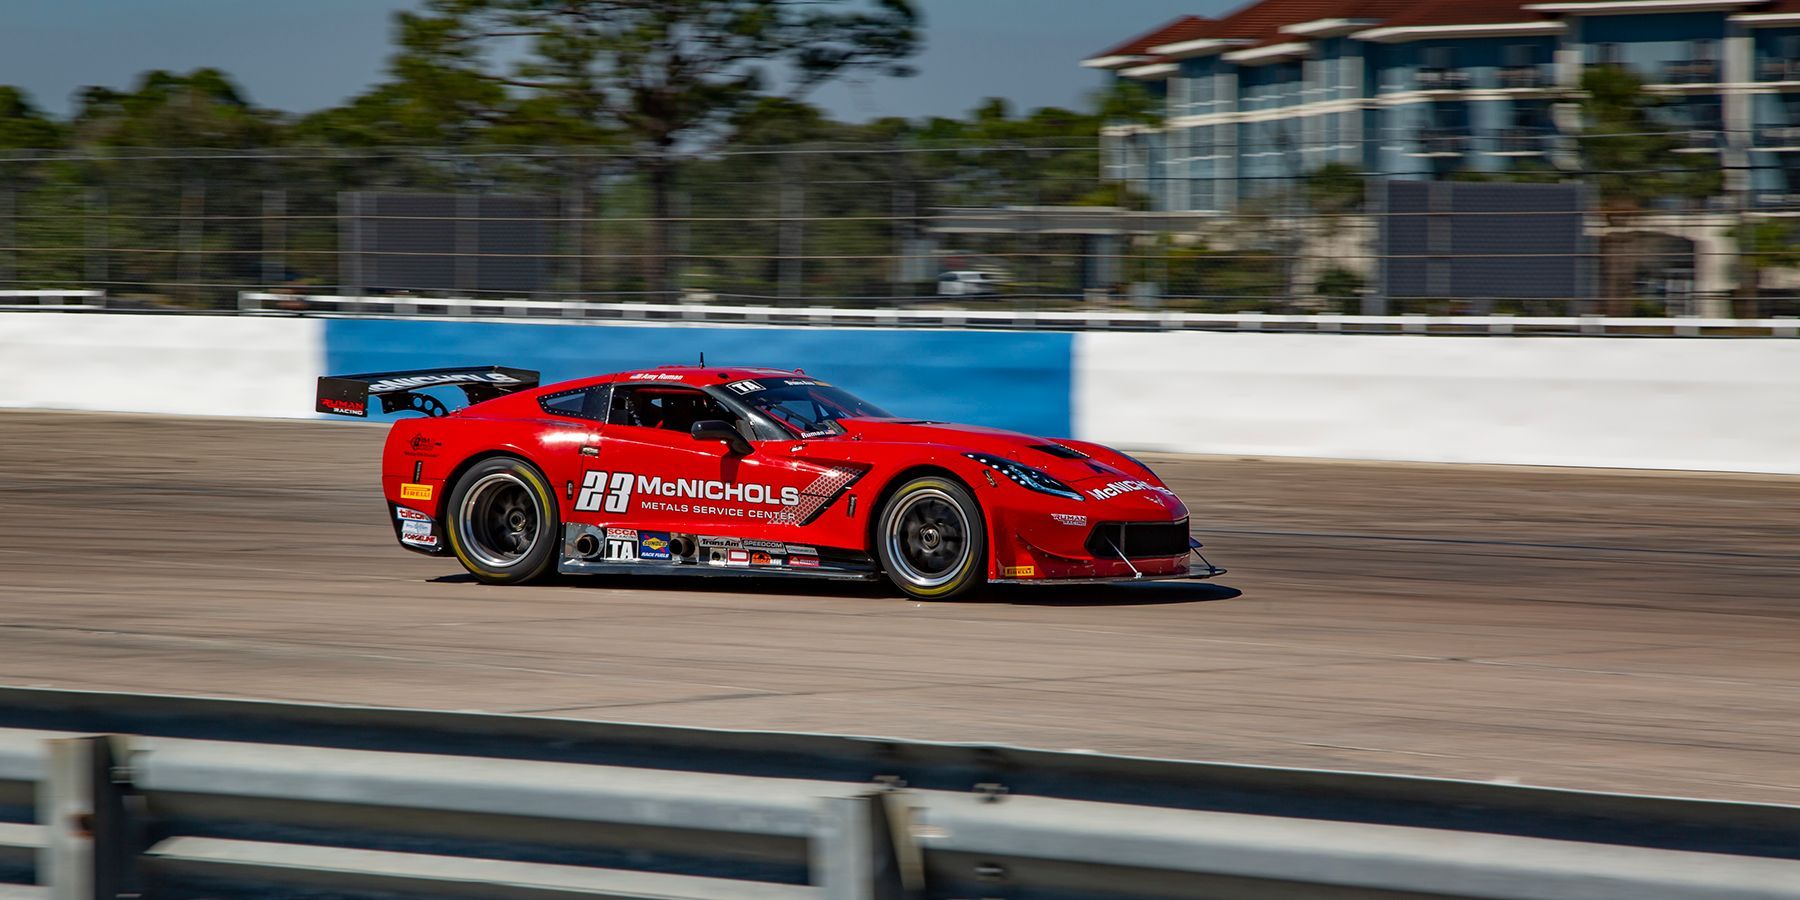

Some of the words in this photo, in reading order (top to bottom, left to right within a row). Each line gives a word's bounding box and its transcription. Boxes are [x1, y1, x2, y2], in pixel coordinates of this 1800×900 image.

[641, 374, 657, 382] Amy
[658, 373, 683, 381] Ruman
[735, 381, 762, 392] TA
[321, 398, 365, 409] RUMAN
[333, 407, 363, 416] RACING
[800, 430, 826, 439] Ruman
[403, 486, 431, 497] PIRELLI
[574, 469, 635, 514] 23
[637, 475, 799, 506] McNICHOLS
[641, 501, 689, 513] METALS
[693, 506, 743, 517] SERVICE
[748, 509, 796, 520] CENTER
[1052, 513, 1087, 521] RUMAN
[607, 528, 637, 536] SCCA
[702, 538, 724, 546] Trans
[743, 540, 783, 549] SPEEDCOM
[609, 540, 634, 561] TA
